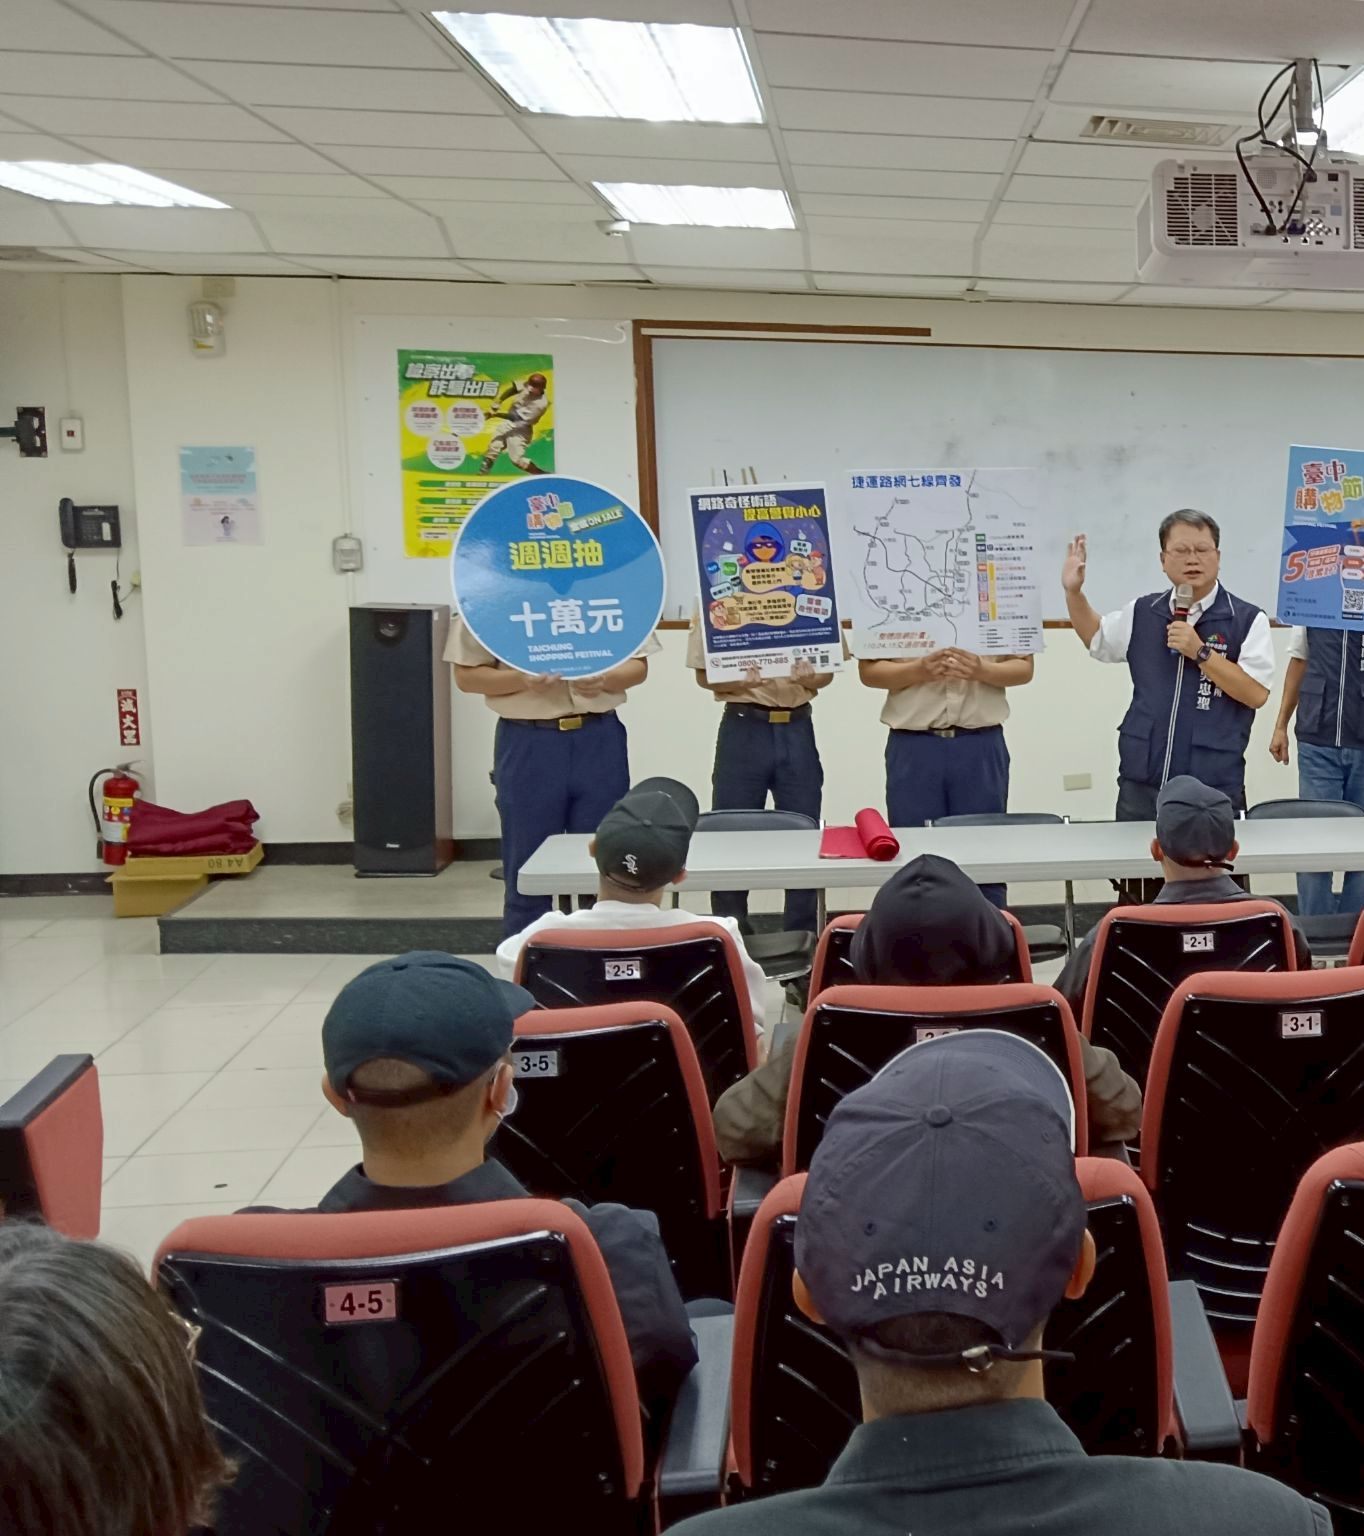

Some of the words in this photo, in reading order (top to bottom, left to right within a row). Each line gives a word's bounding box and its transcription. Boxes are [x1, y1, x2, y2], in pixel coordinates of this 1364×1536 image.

[852, 474, 963, 489] 捷運路網七線齊發
[1302, 459, 1346, 486] 臺中
[508, 539, 604, 570] 週週抽
[509, 598, 624, 638] 十萬元
[1190, 936, 1208, 948] 2-1
[612, 964, 635, 977] 2-5
[1290, 1016, 1313, 1032] 3-1
[520, 1055, 549, 1072] 3-5
[851, 1256, 929, 1292] JAPAN
[943, 1257, 1004, 1290] ASIA
[873, 1273, 989, 1300] AIRWAYS
[340, 1290, 384, 1315] 4-5
